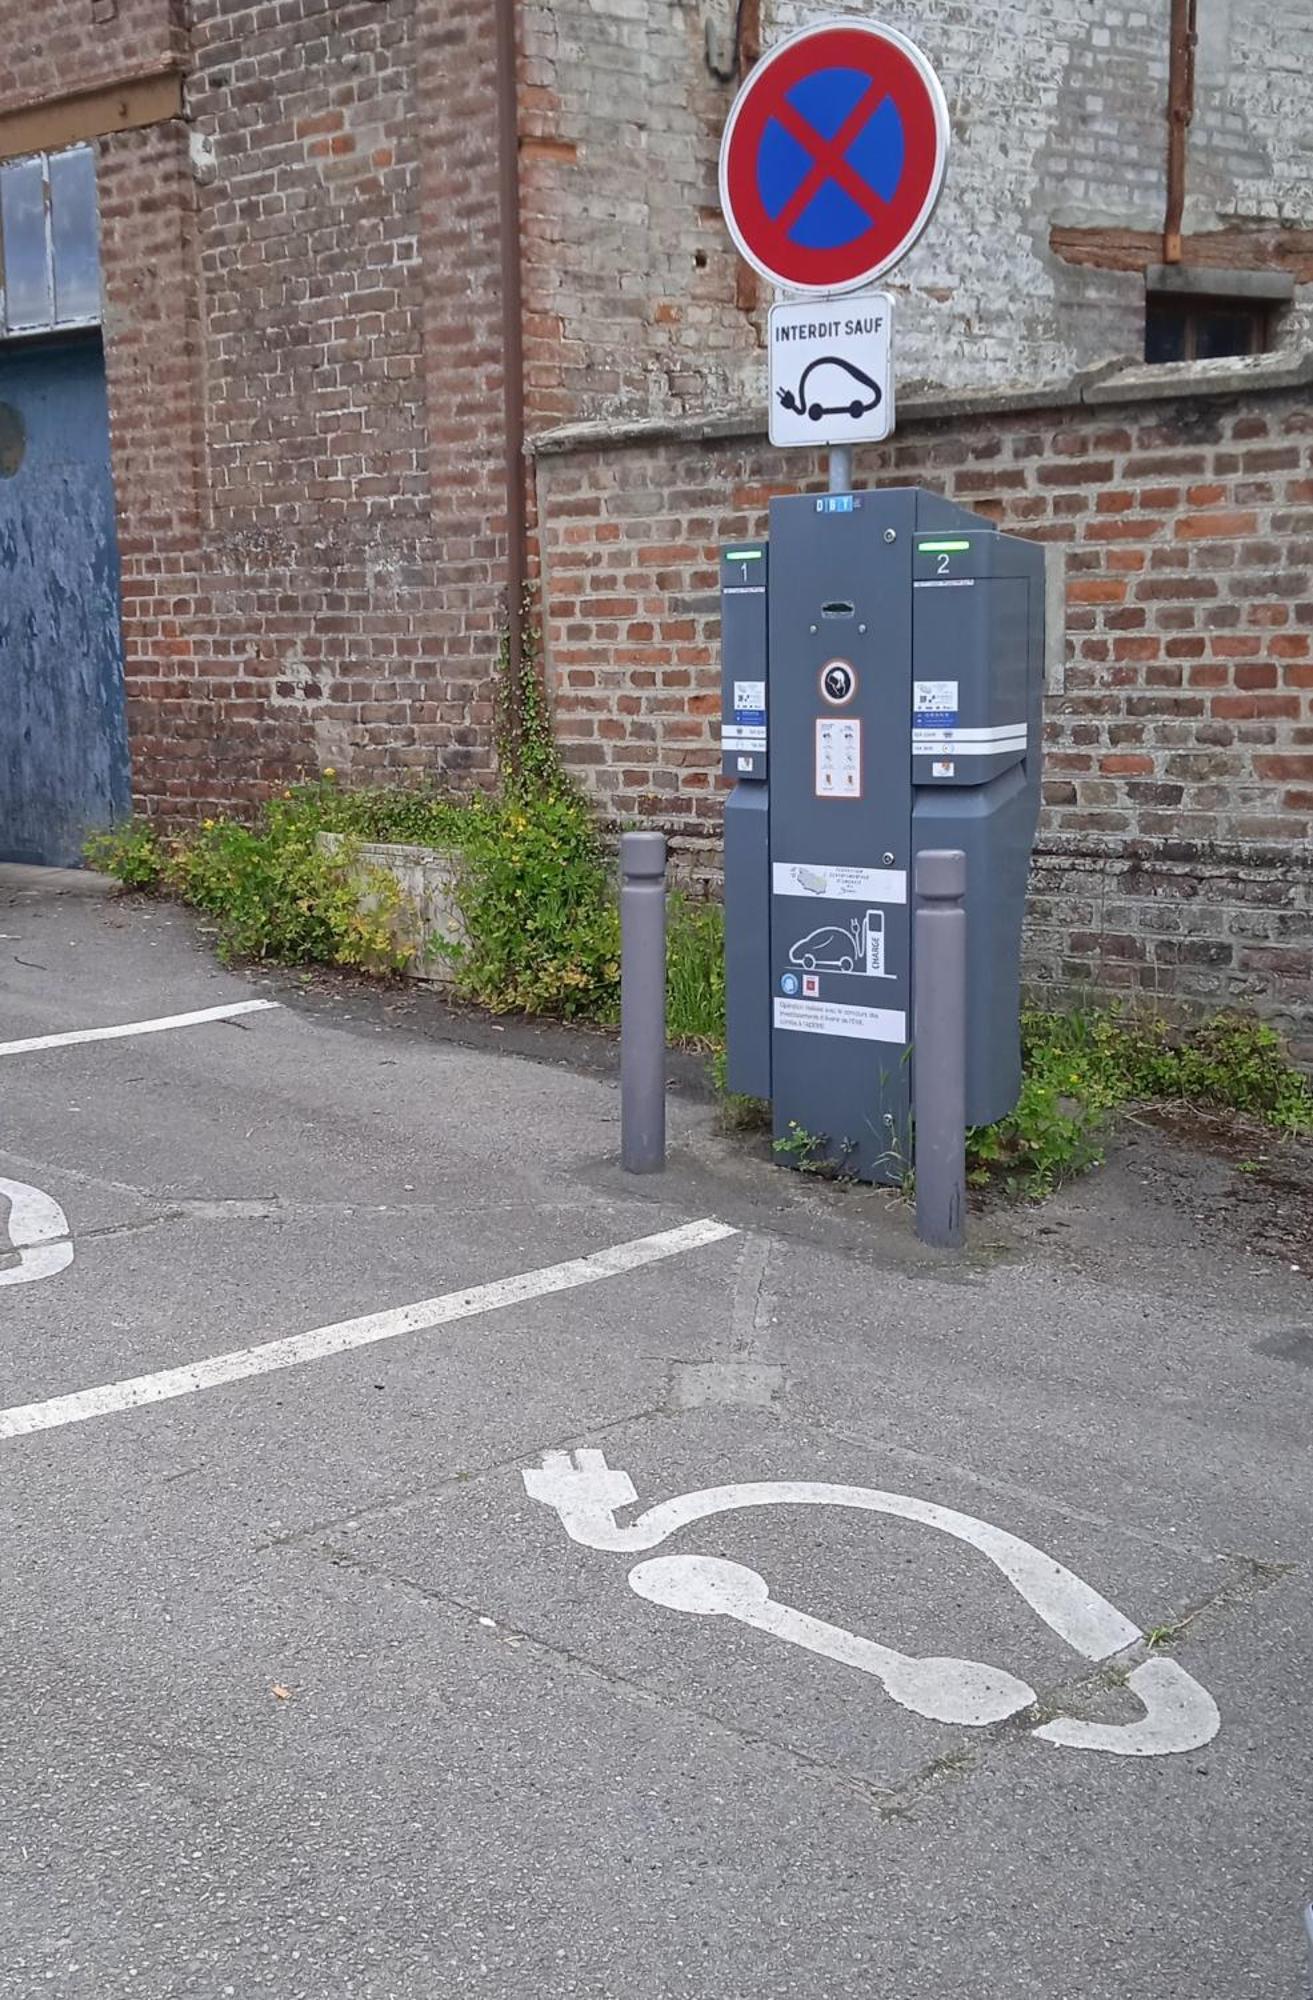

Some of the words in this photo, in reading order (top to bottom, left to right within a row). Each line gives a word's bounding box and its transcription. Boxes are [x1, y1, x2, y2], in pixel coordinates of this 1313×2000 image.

[775, 321, 841, 342] INTERDIT
[844, 317, 883, 336] SAUF
[740, 562, 748, 582] 1
[937, 553, 950, 574] 2
[871, 937, 880, 969] CHARGE
